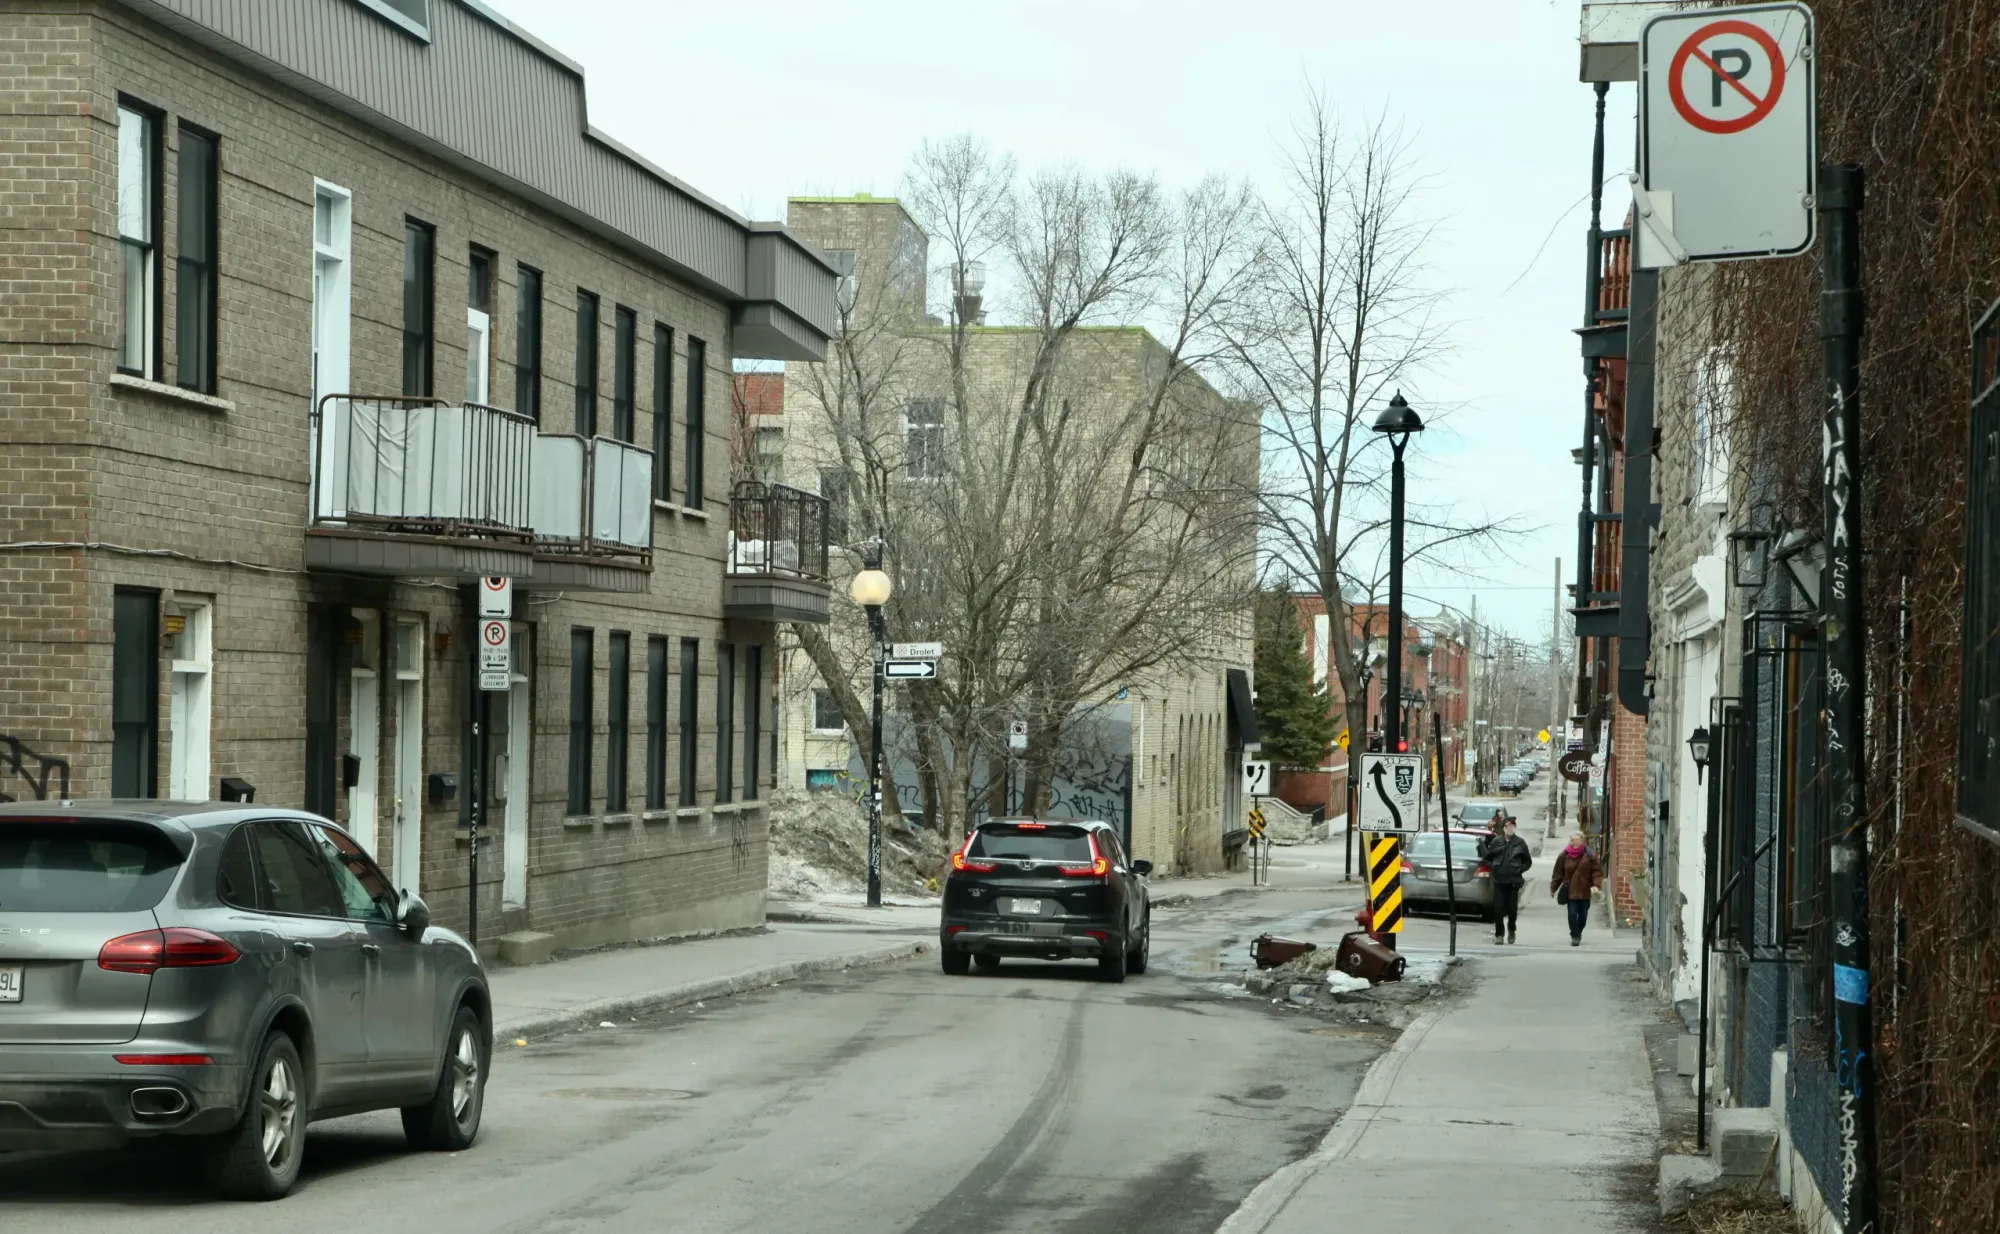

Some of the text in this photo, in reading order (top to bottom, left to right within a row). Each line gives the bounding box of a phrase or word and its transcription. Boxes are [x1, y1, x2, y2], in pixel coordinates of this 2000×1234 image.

[1711, 48, 1752, 108] P
[492, 627, 499, 640] P
[1566, 760, 1590, 774] Coffee
